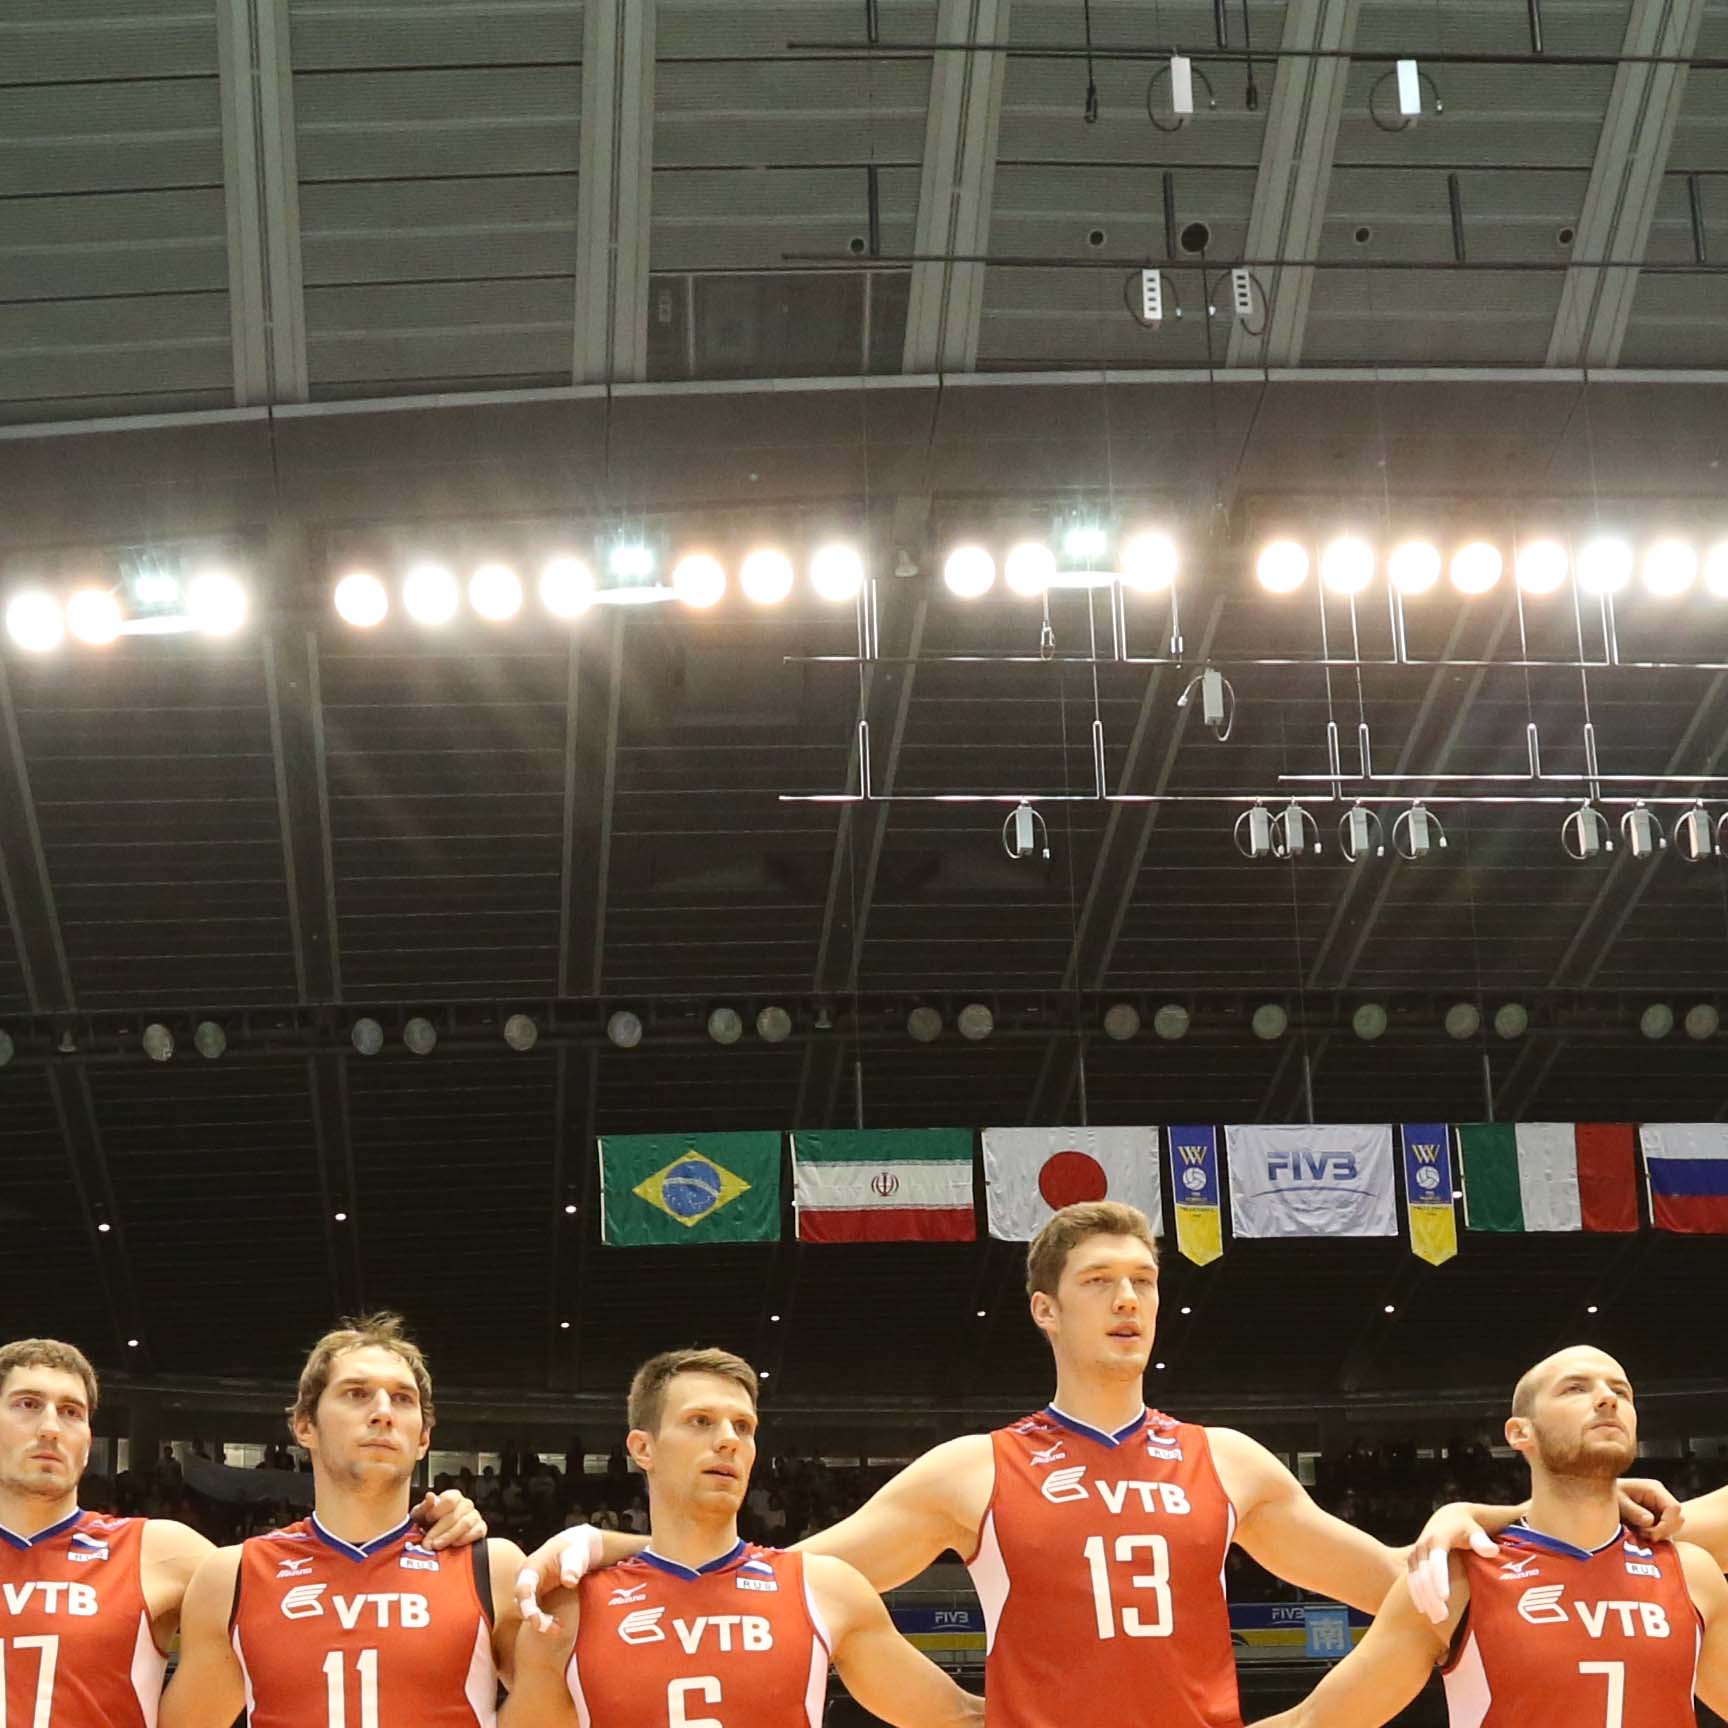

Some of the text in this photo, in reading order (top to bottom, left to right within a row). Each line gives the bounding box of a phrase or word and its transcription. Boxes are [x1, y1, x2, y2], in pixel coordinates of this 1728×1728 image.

[1267, 1151, 1358, 1181] FIVB
[1094, 1480, 1192, 1515] VTB
[3, 1582, 98, 1616] VTB
[1083, 1534, 1174, 1640] 13
[333, 1593, 431, 1629] VTB
[934, 1611, 969, 1623] FIVB
[1574, 1601, 1670, 1638] VTB
[672, 1615, 773, 1654] VTB
